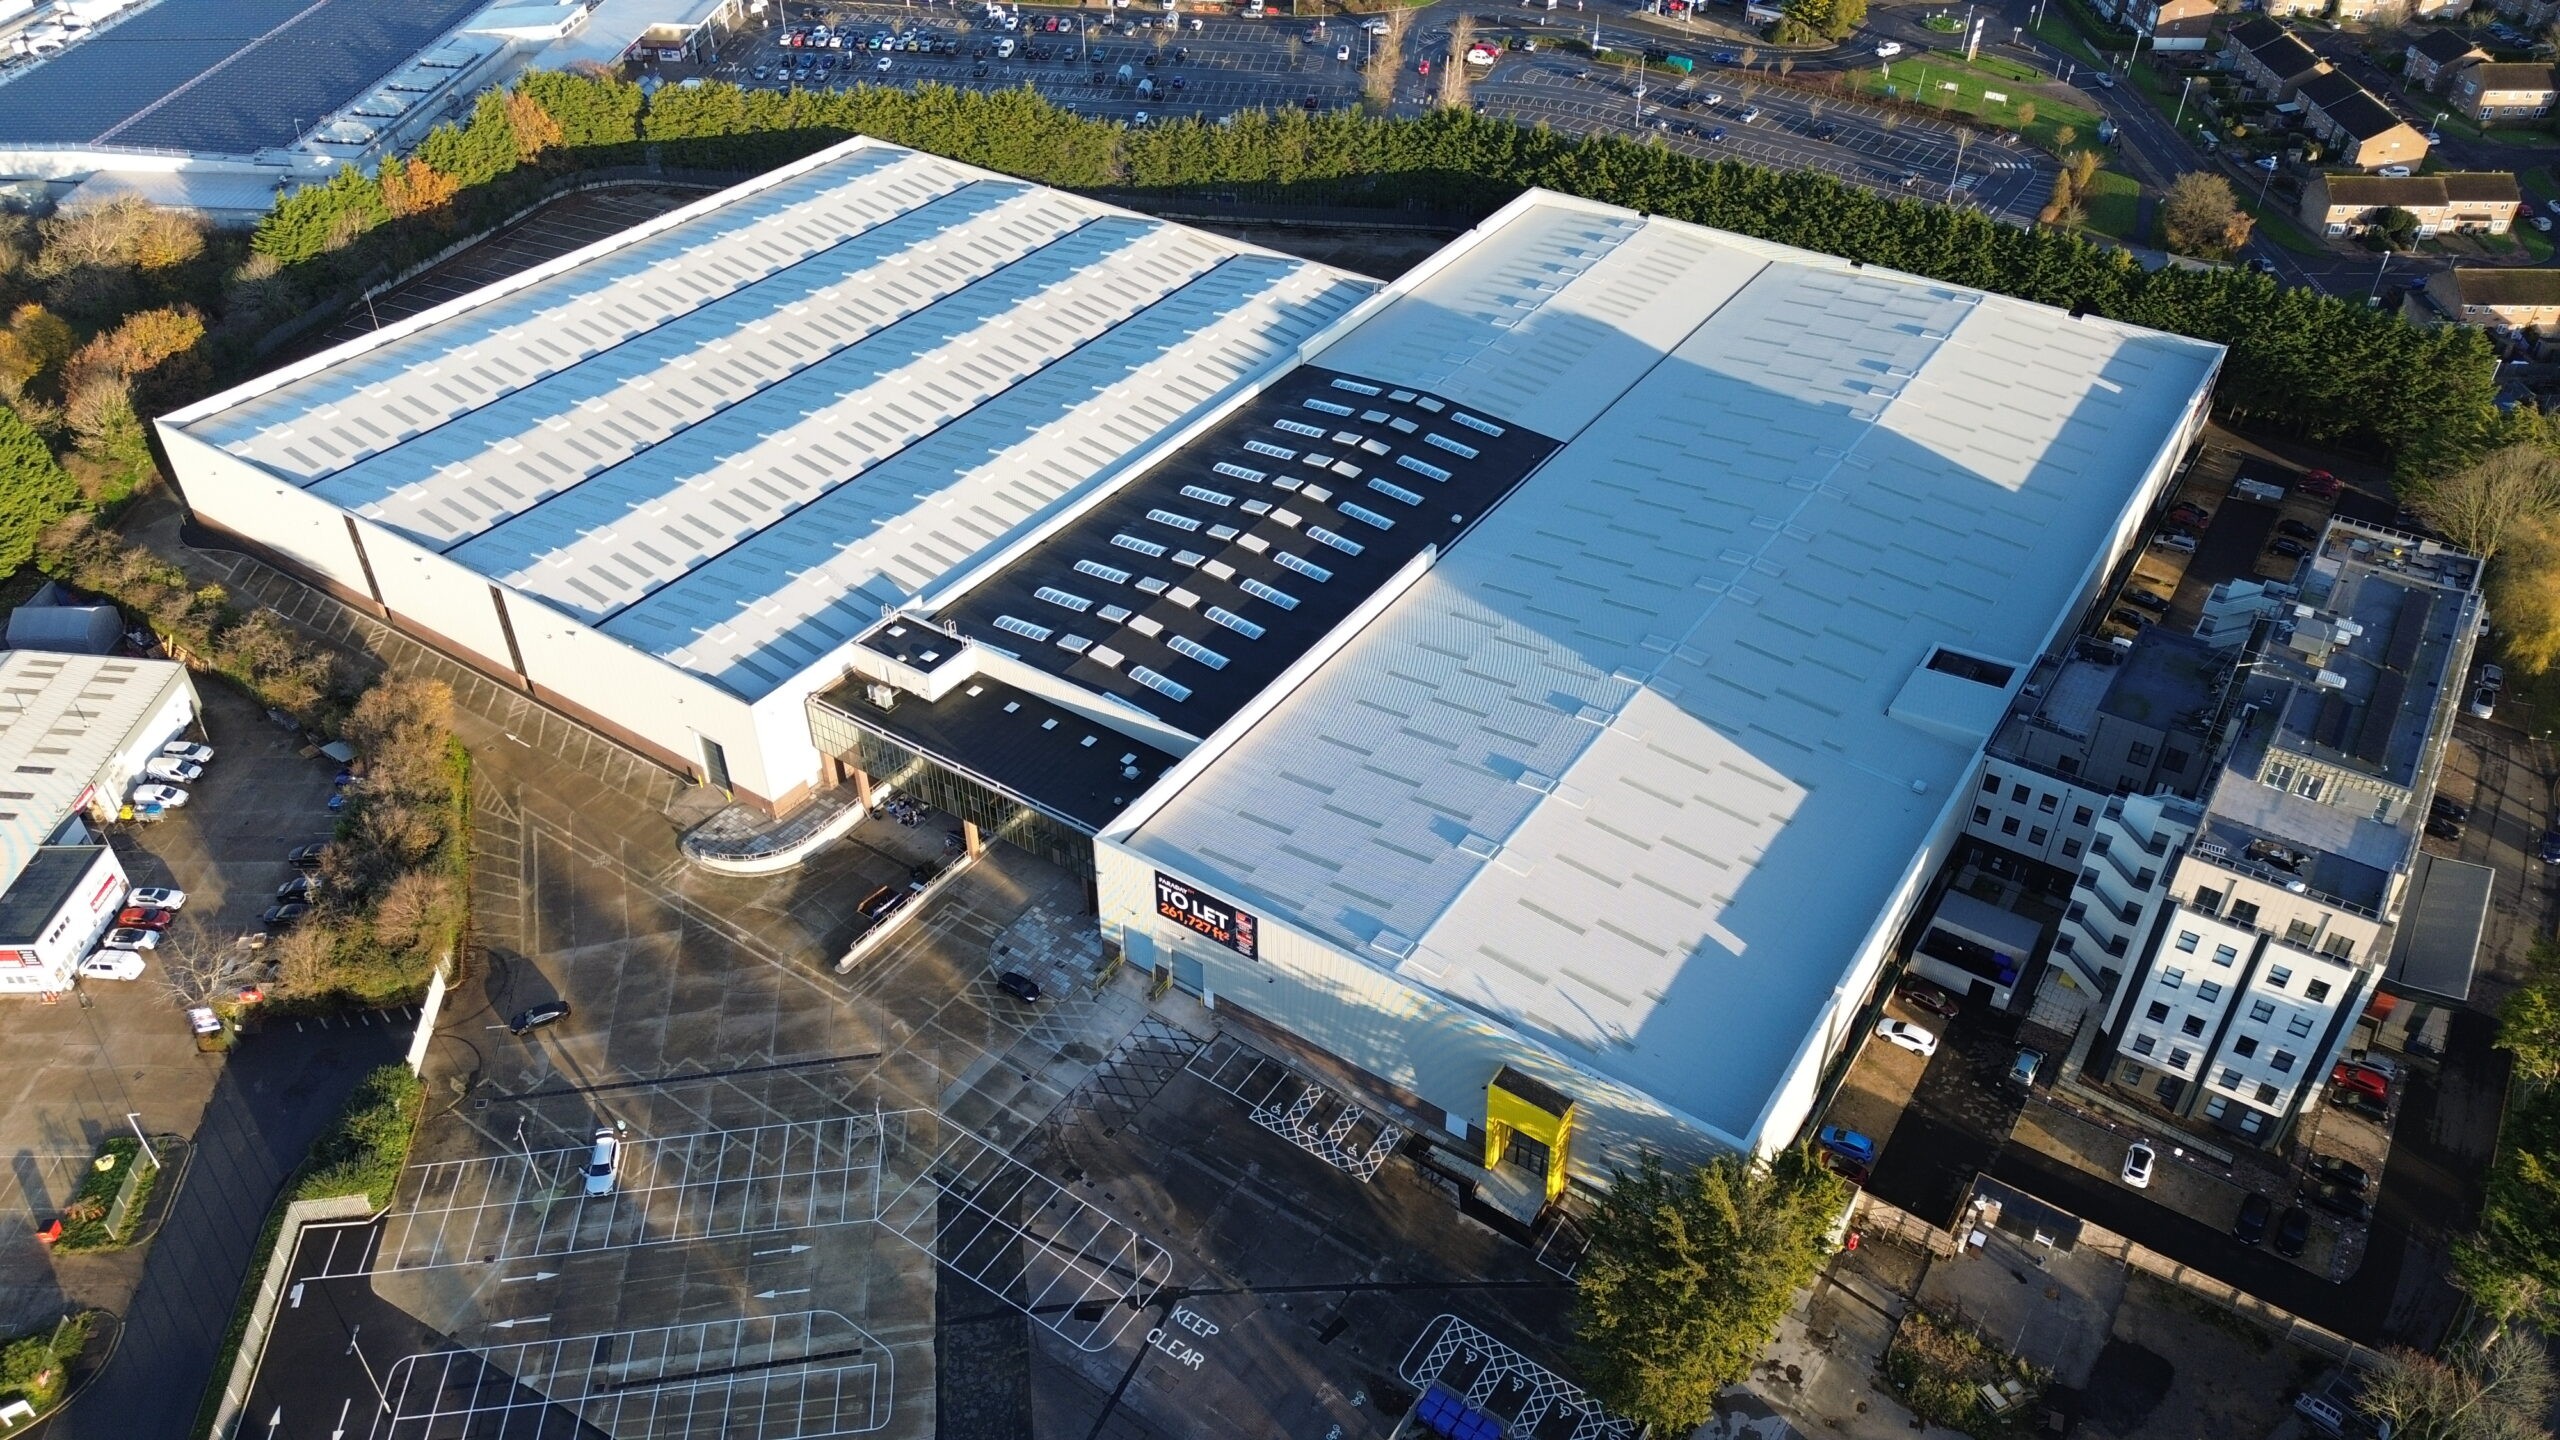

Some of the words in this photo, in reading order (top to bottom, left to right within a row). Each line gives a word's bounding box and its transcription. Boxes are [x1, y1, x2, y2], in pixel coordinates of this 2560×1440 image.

[1158, 884, 1189, 910] TO
[1192, 900, 1229, 930] LET
[1160, 902, 1212, 934] 261,727
[1170, 1305, 1219, 1338] KEEP
[1146, 1328, 1205, 1371] CLEAR
